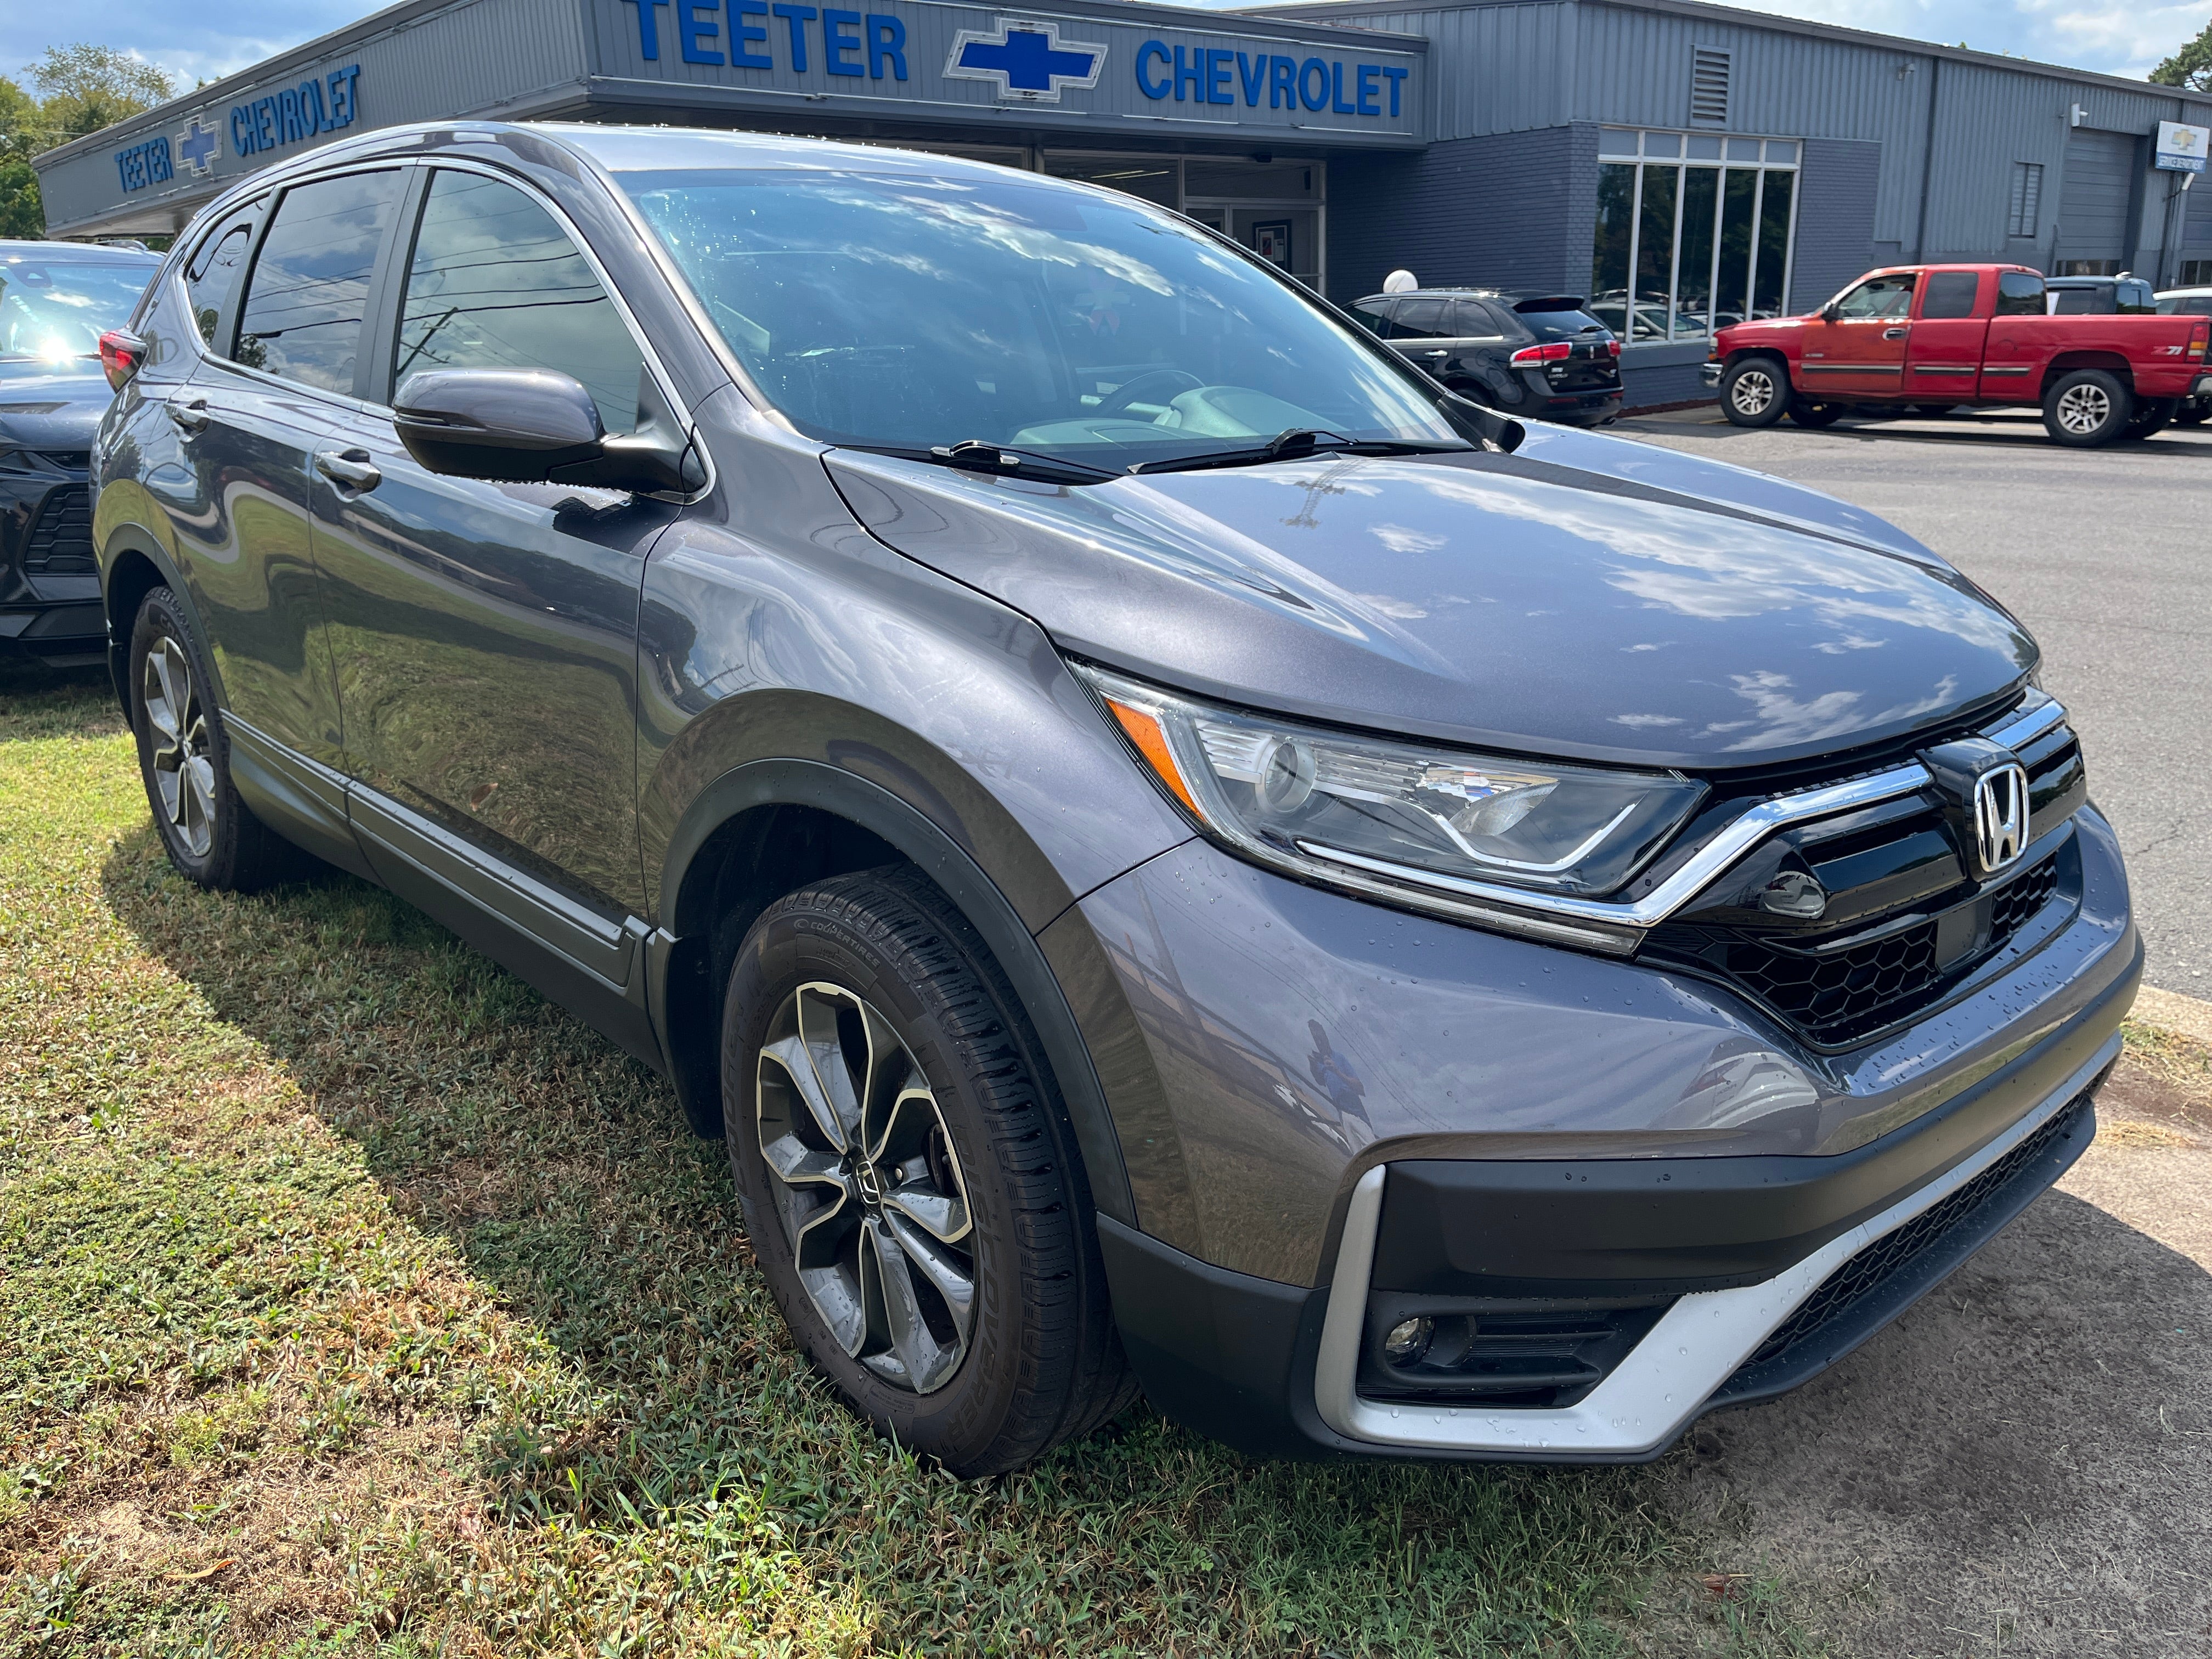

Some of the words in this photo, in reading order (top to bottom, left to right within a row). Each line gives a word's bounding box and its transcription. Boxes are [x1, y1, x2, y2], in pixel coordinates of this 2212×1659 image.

[621, 0, 907, 81] TEETER
[1136, 40, 1408, 117] CHEVROLET
[114, 136, 174, 193] TEETER
[230, 64, 360, 157] CHEVROLET
